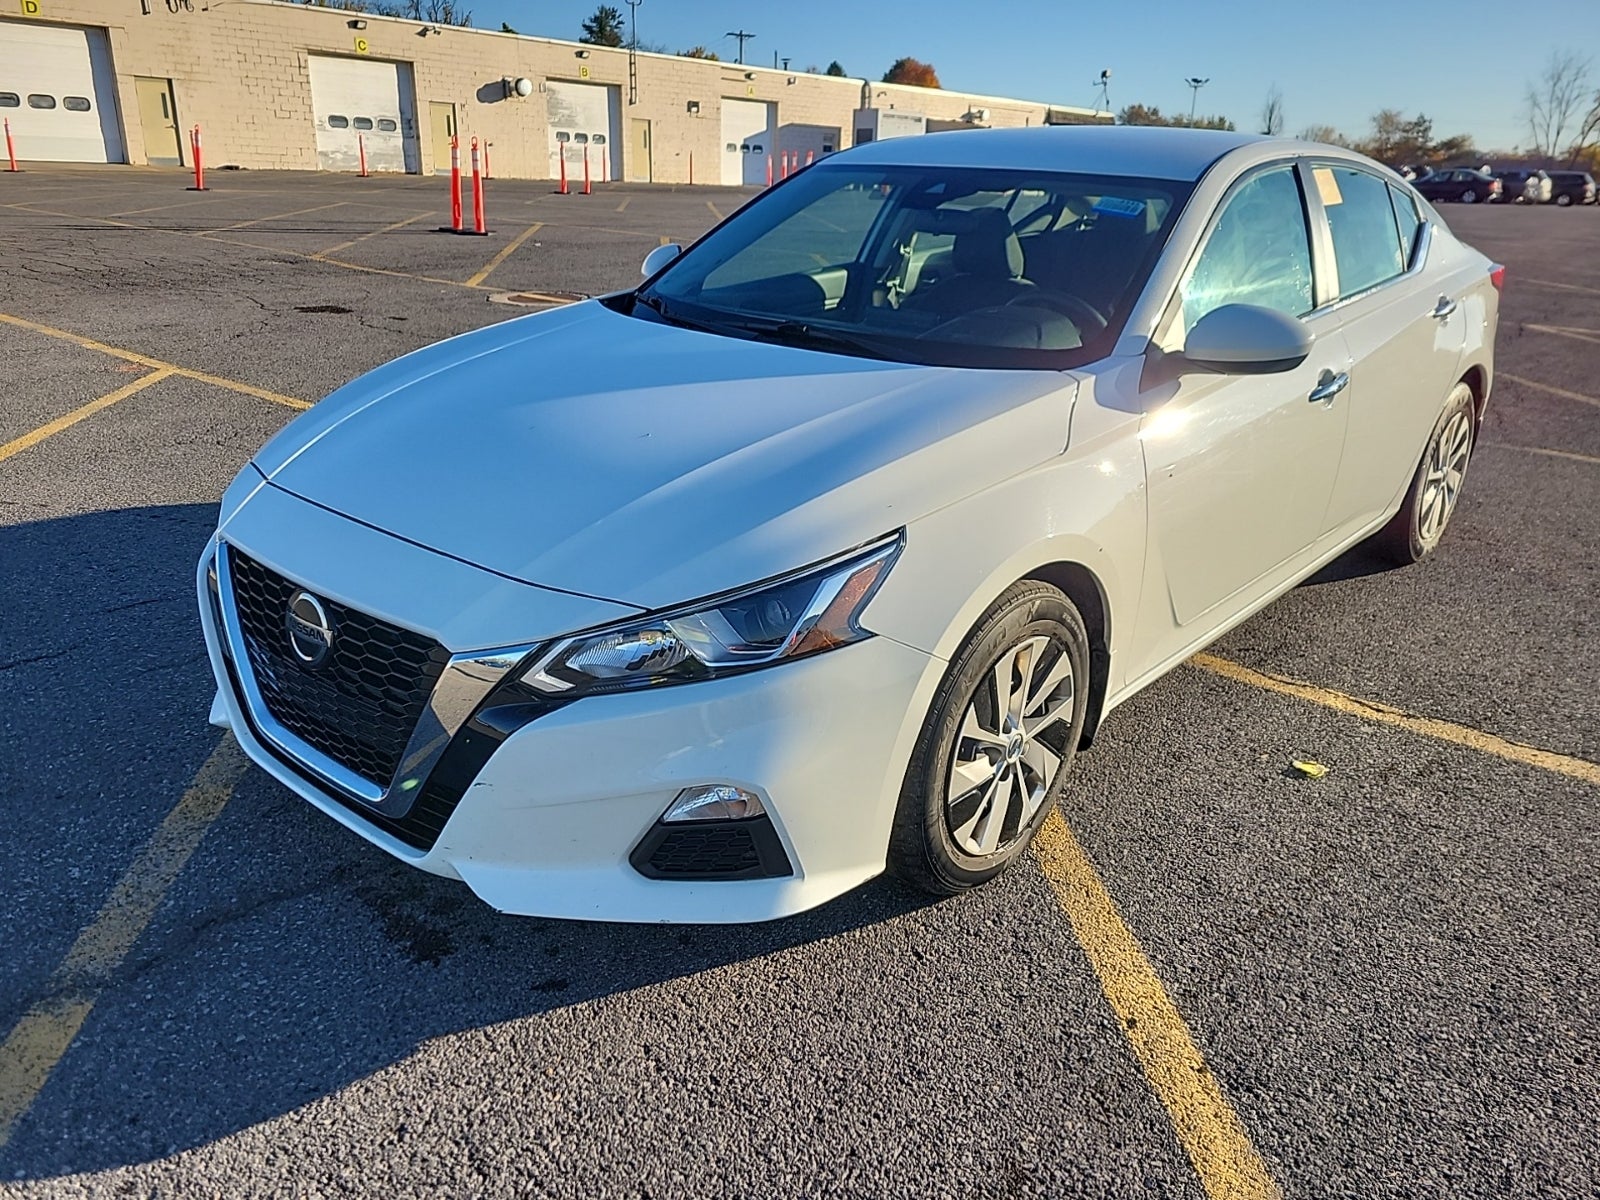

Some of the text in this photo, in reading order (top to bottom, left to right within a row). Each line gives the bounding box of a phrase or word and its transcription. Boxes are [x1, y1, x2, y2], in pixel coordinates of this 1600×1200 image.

[26, 1, 37, 13] D
[358, 40, 366, 51] C
[582, 67, 588, 77] B
